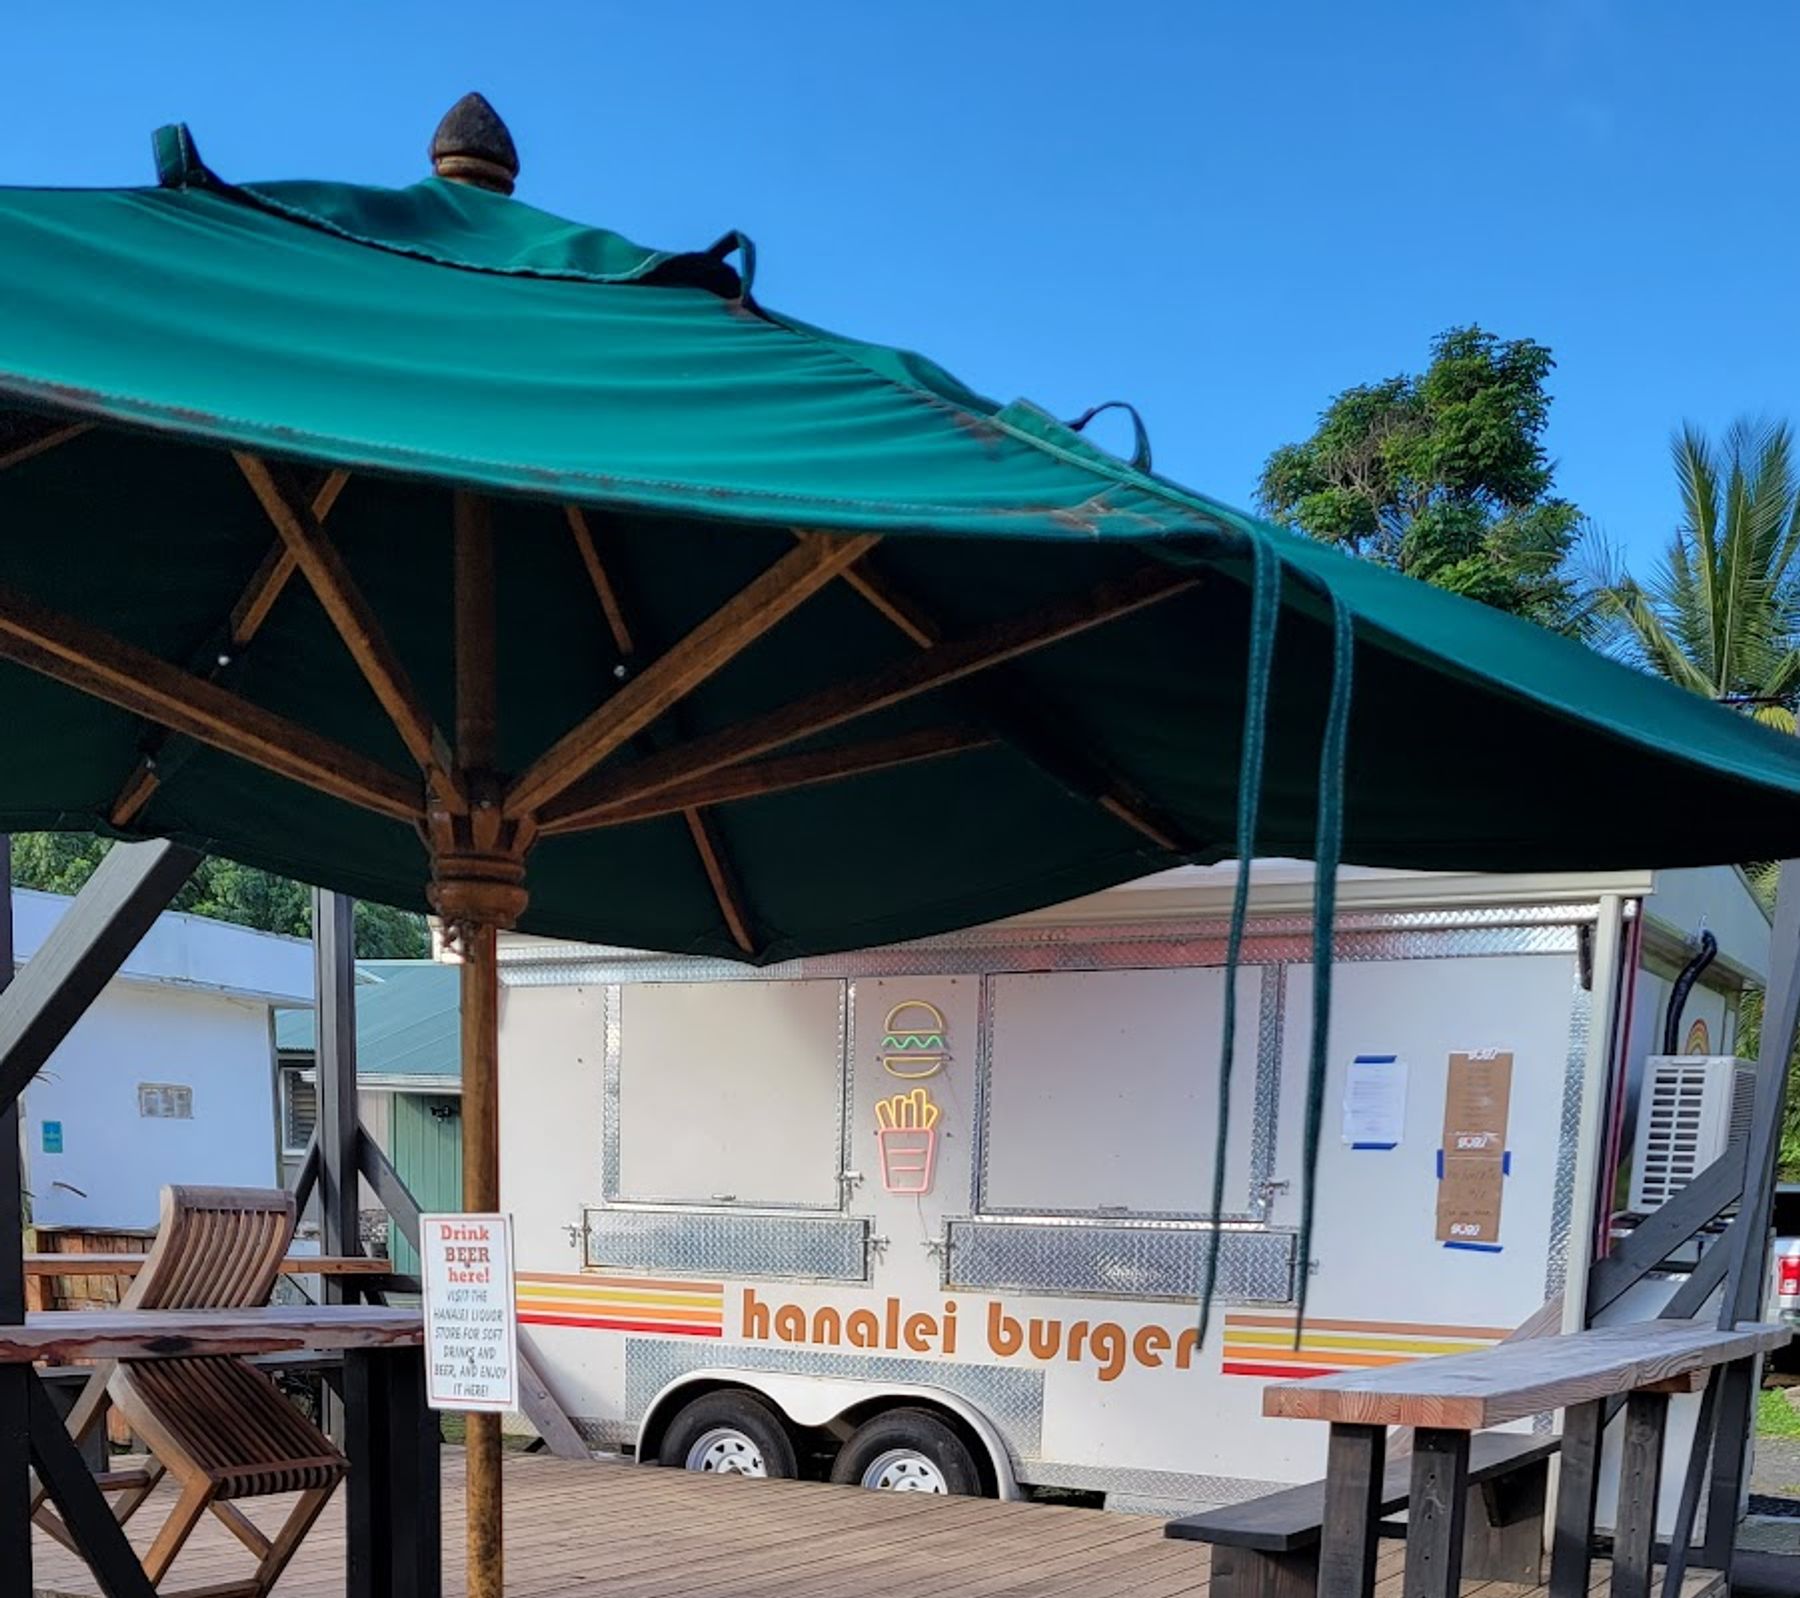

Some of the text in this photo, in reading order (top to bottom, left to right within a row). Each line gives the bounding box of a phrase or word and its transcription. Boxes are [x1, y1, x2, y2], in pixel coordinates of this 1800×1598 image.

[440, 1224, 489, 1241] Drink
[445, 1246, 490, 1263] BEER
[448, 1266, 490, 1283] here!
[447, 1289, 487, 1303] VISIT THE
[433, 1308, 503, 1322] HANALEI LIQUOR
[435, 1326, 503, 1341] STORE FOR SOFT
[742, 1288, 1200, 1382] hanalei burger
[443, 1345, 497, 1360] DRINKS AND
[460, 1365, 478, 1378] AND
[480, 1365, 507, 1380] ENJOY
[453, 1383, 489, 1397] IT HERE!
